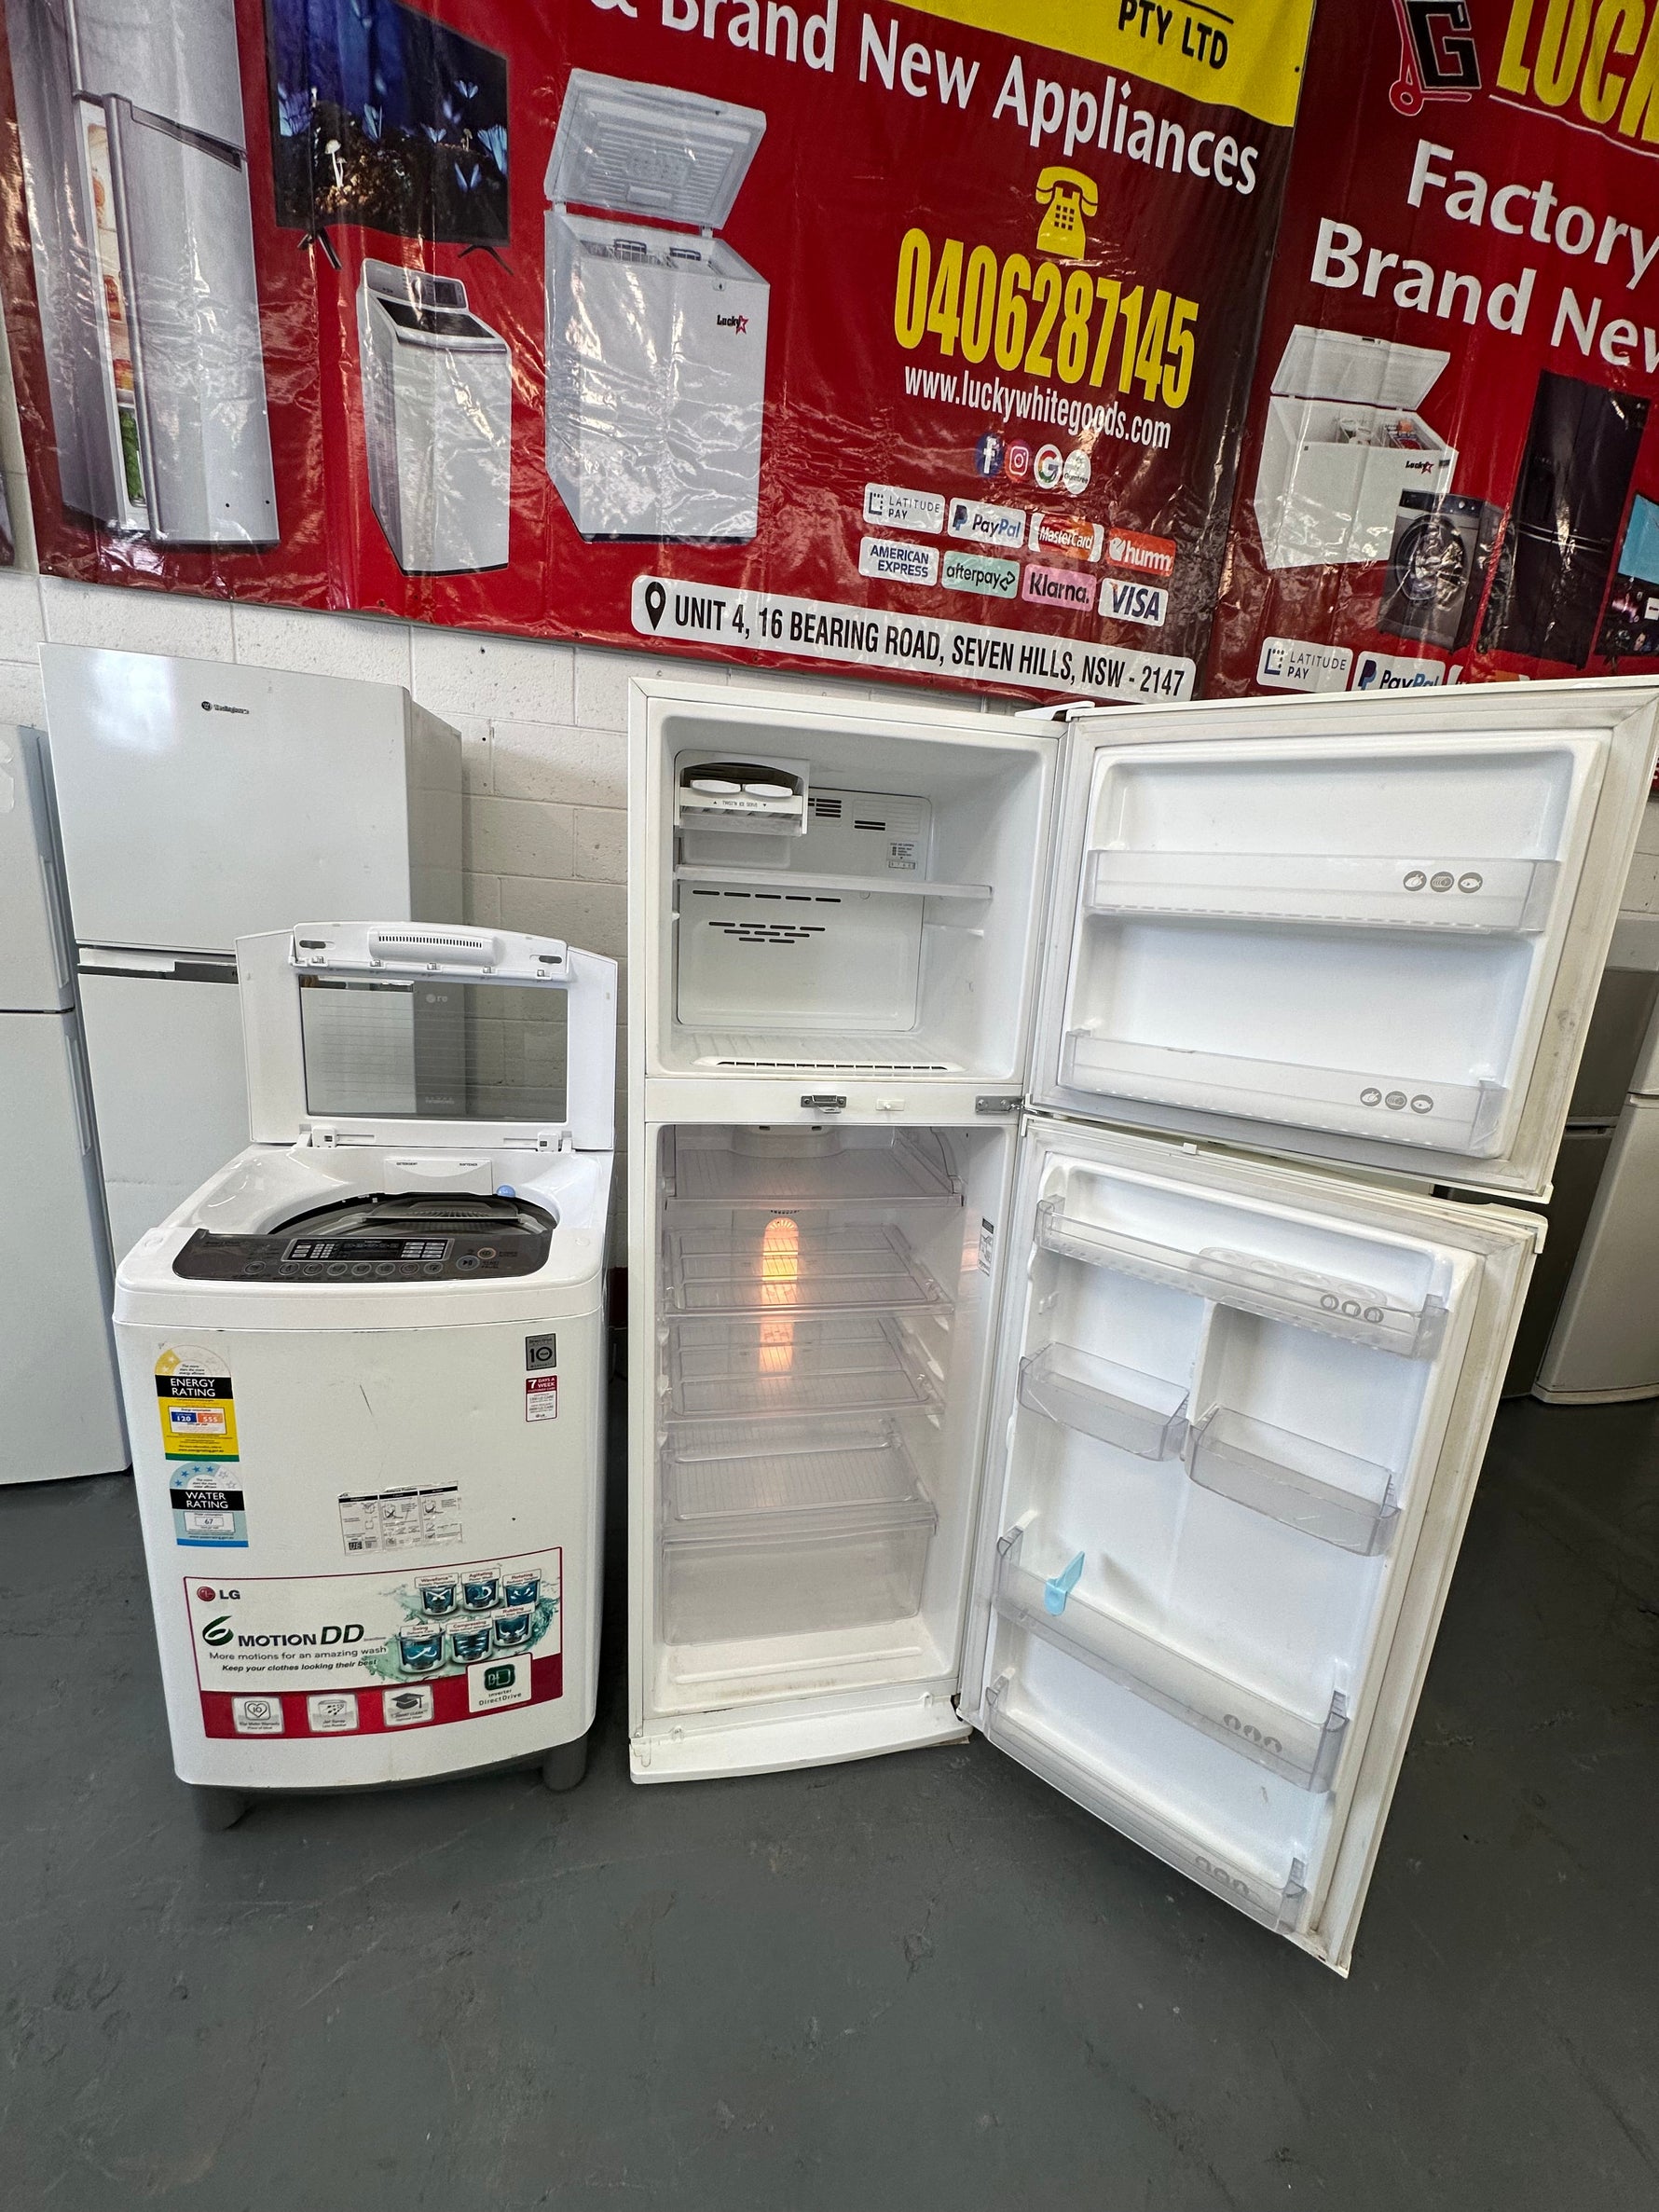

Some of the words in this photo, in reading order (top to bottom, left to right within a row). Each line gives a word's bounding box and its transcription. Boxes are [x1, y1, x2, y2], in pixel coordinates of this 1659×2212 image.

[1117, 3, 1172, 47] PTY
[1182, 20, 1228, 70] LTD
[858, 19, 980, 109] New
[993, 73, 1258, 195] Appliances
[1407, 139, 1659, 290] Factory
[1310, 217, 1537, 336] Brand
[894, 227, 1200, 409] 0406287145
[904, 365, 1172, 449] www.luckywhitegoods.com
[888, 495, 940, 514] LATITUDE
[888, 508, 909, 520] PAY
[972, 514, 1021, 538] PayPal
[1037, 526, 1094, 551] MasterCard
[870, 543, 929, 564] AMERICAN
[877, 560, 929, 578] EXPRESS
[946, 563, 1001, 589] afterpay
[1029, 571, 1090, 604] Klarna.
[1110, 583, 1160, 621] VISA
[675, 594, 726, 629] UNIT
[731, 601, 750, 640] 4,
[759, 607, 782, 640] 16
[789, 611, 878, 655] BEARING
[885, 625, 944, 667] ROAD,
[952, 635, 1014, 674] SEVEN
[1022, 646, 1076, 687] HILLS,
[1082, 657, 1124, 689] NSW
[1141, 665, 1186, 697] 2147
[1290, 651, 1347, 670] LATITUDE
[1287, 666, 1309, 680] PAY
[171, 1378, 215, 1388] ENERGY
[171, 1387, 216, 1397] RATING
[528, 1379, 538, 1389] 7
[185, 1491, 226, 1501] WATER
[186, 1500, 228, 1509] RATING
[219, 1589, 240, 1600] LG
[238, 1634, 317, 1647] MOTION
[321, 1624, 364, 1645] DD
[210, 1652, 235, 1660] More
[238, 1652, 279, 1660] motions
[314, 1649, 358, 1659] amazing
[361, 1646, 387, 1655] wash
[301, 1662, 333, 1671] looking
[336, 1660, 355, 1669] their
[488, 1689, 512, 1697] Inverter
